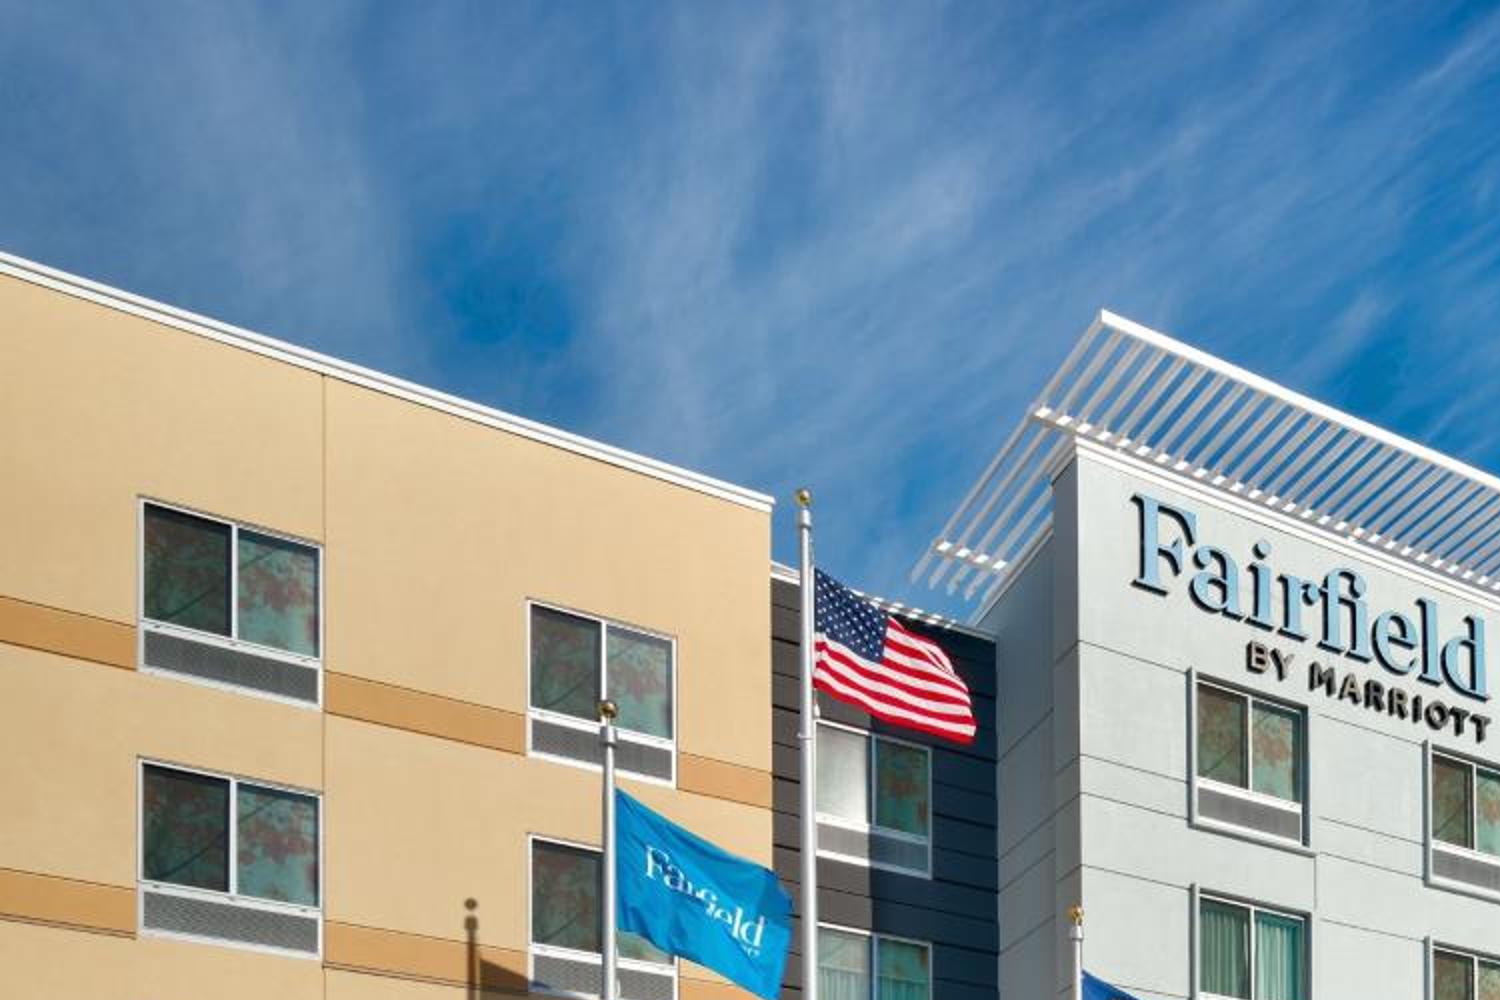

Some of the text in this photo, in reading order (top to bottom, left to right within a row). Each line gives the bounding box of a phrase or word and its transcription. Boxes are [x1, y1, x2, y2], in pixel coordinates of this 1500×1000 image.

[1130, 493, 1492, 702] Fairfield
[1246, 640, 1492, 743] BY MARRIOTT
